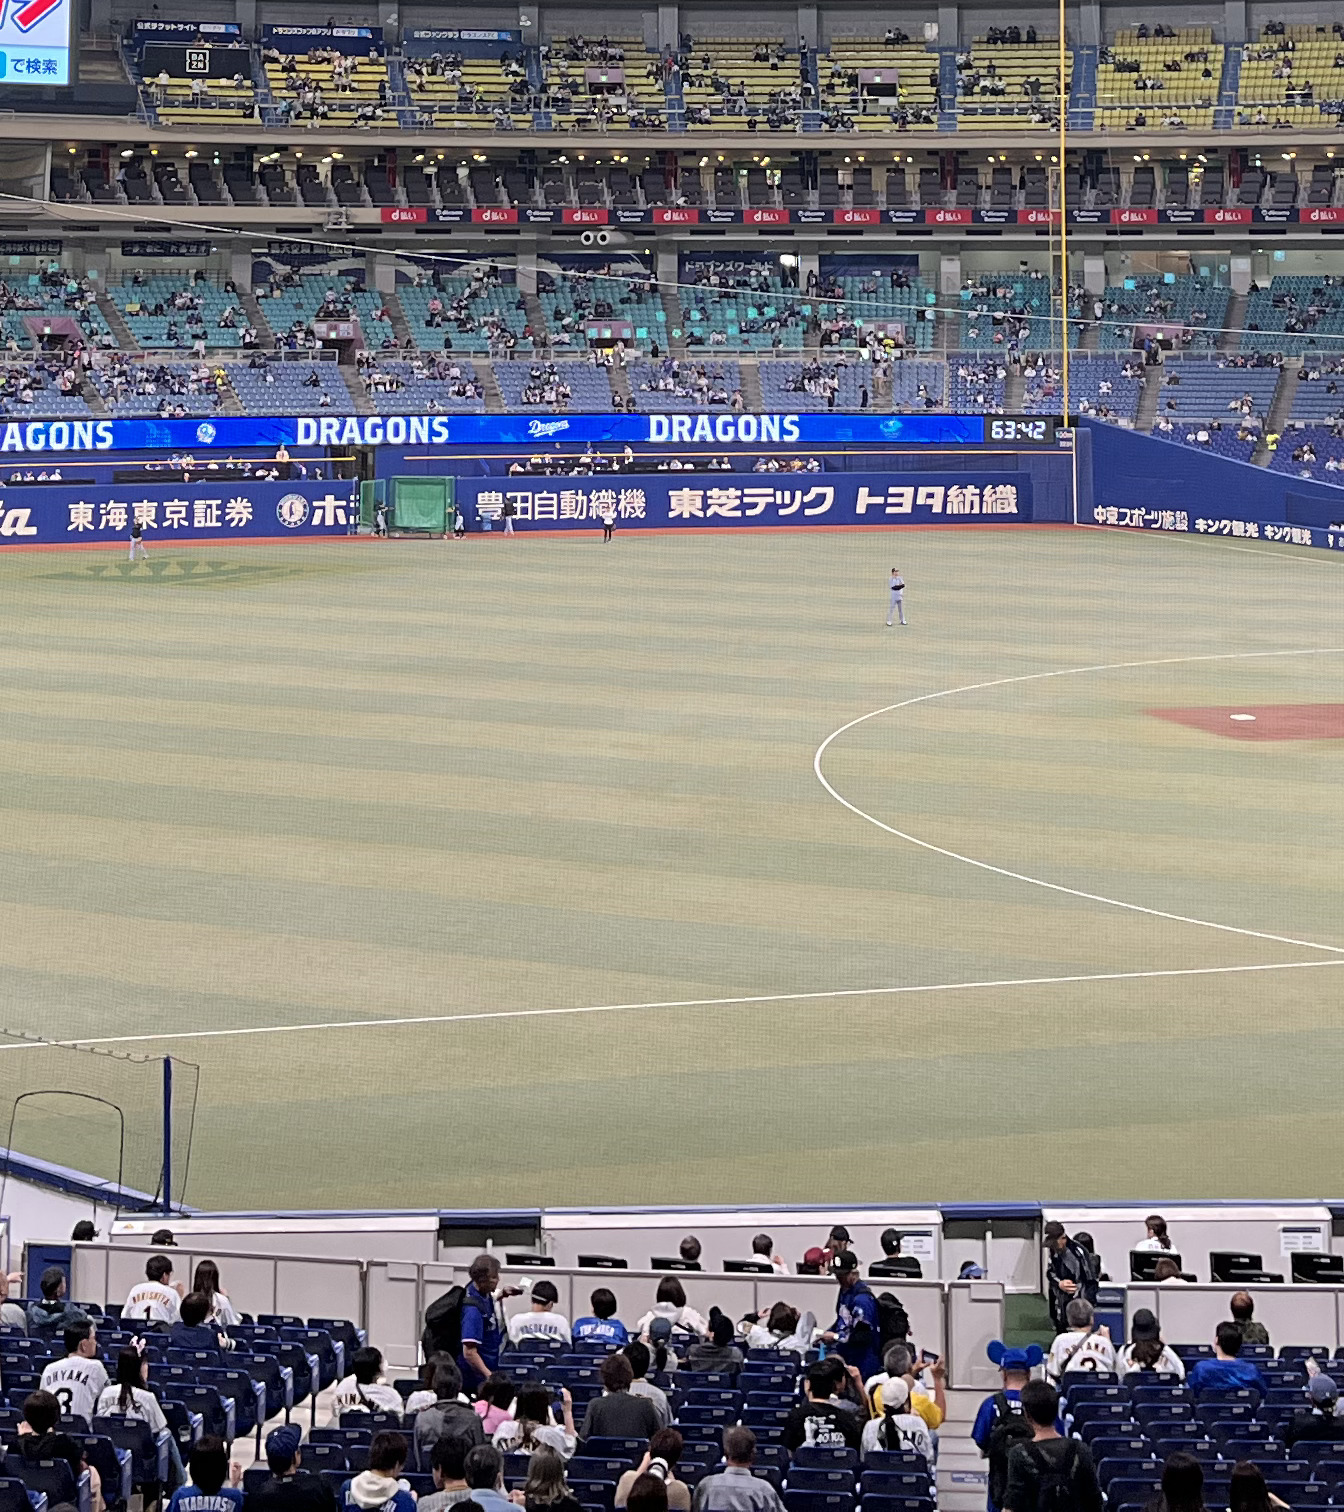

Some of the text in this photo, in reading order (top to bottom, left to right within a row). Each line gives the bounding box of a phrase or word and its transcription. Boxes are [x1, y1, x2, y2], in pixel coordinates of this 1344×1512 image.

[11, 58, 58, 75] で検索
[297, 417, 449, 445] DRAGONS
[528, 419, 569, 438] Dragons
[650, 414, 800, 442] DRAGONS
[991, 420, 1046, 440] 63:42
[67, 497, 254, 532] 東海東京証券
[476, 489, 646, 521] 豊田自動織機
[668, 487, 835, 518] 東芝テック
[856, 485, 1018, 516] トヨタ紡織
[1094, 505, 1189, 531] 中京スポーツ施設
[1195, 518, 1259, 538] キング観光
